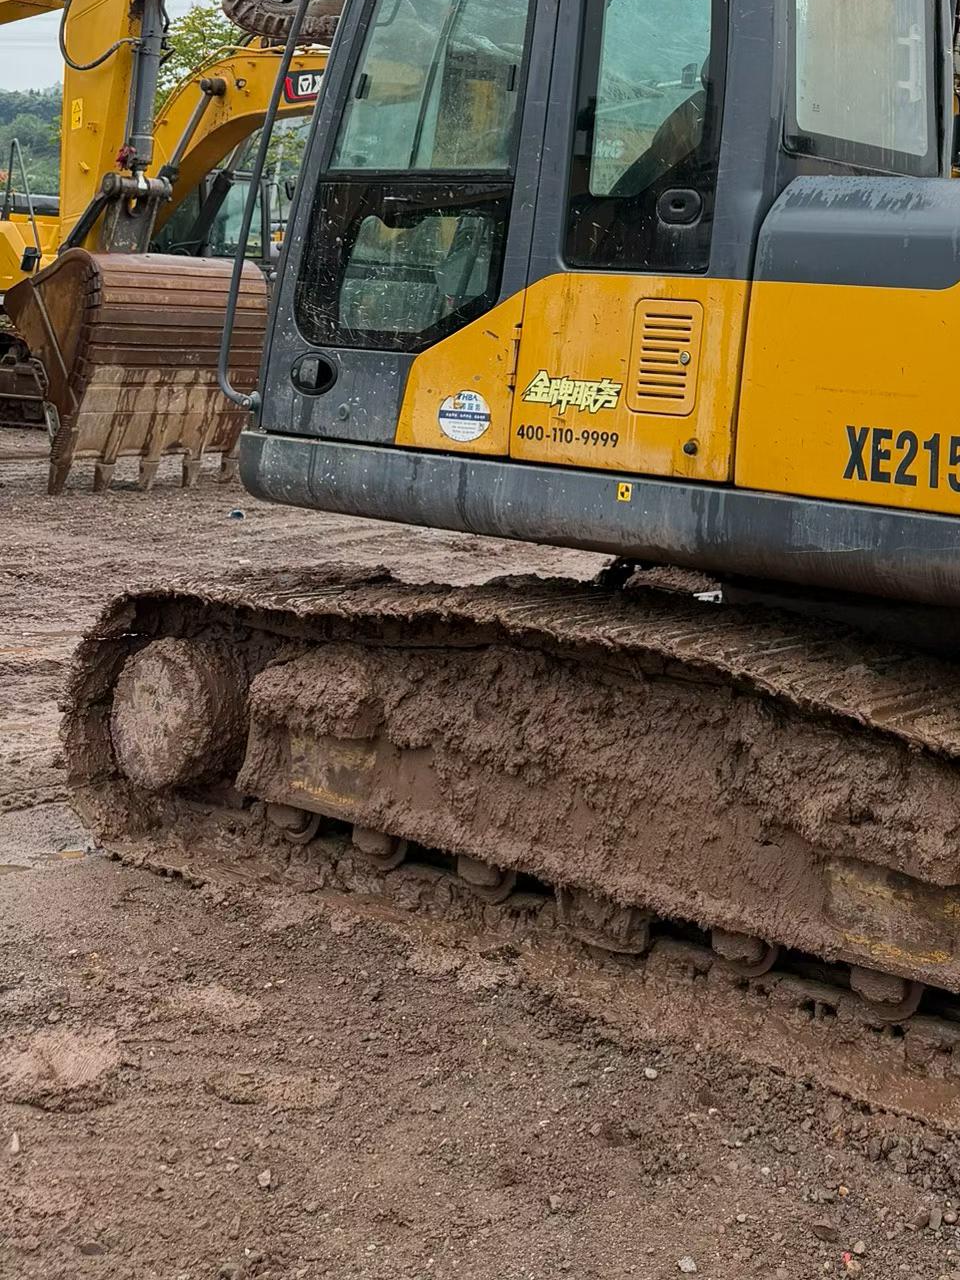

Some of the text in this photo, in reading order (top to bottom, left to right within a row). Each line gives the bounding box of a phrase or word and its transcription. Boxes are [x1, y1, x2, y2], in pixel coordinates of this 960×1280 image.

[522, 370, 623, 415] 金牌服务
[516, 424, 620, 448] 400-110-9999
